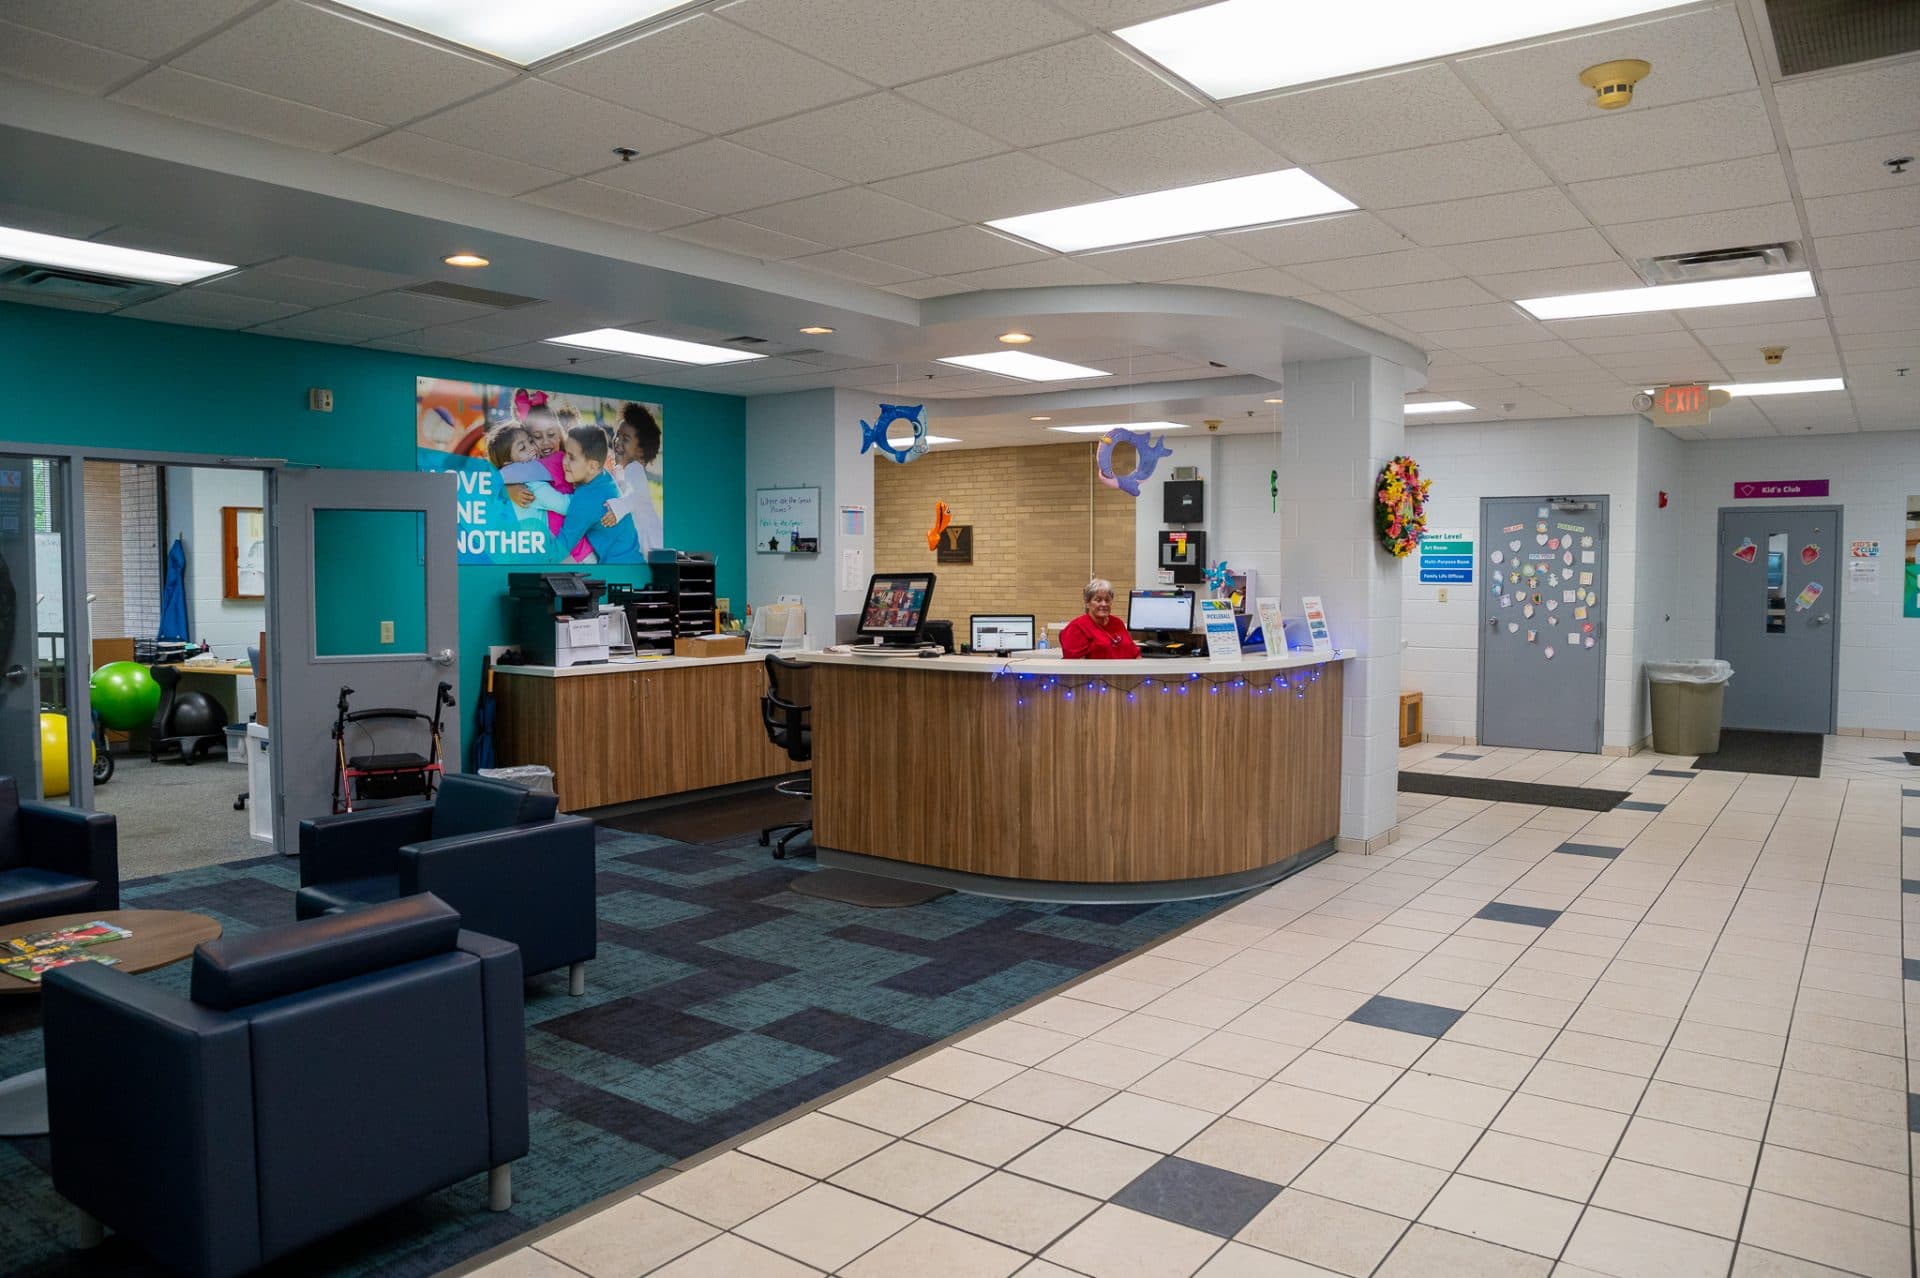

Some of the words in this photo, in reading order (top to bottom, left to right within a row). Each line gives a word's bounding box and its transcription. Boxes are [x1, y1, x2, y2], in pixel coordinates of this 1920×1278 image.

[1664, 386, 1702, 413] EXIT
[1762, 485, 1782, 494] Kid's
[1783, 485, 1801, 493] Club
[457, 501, 487, 524] NE
[457, 530, 546, 554] NOTHER
